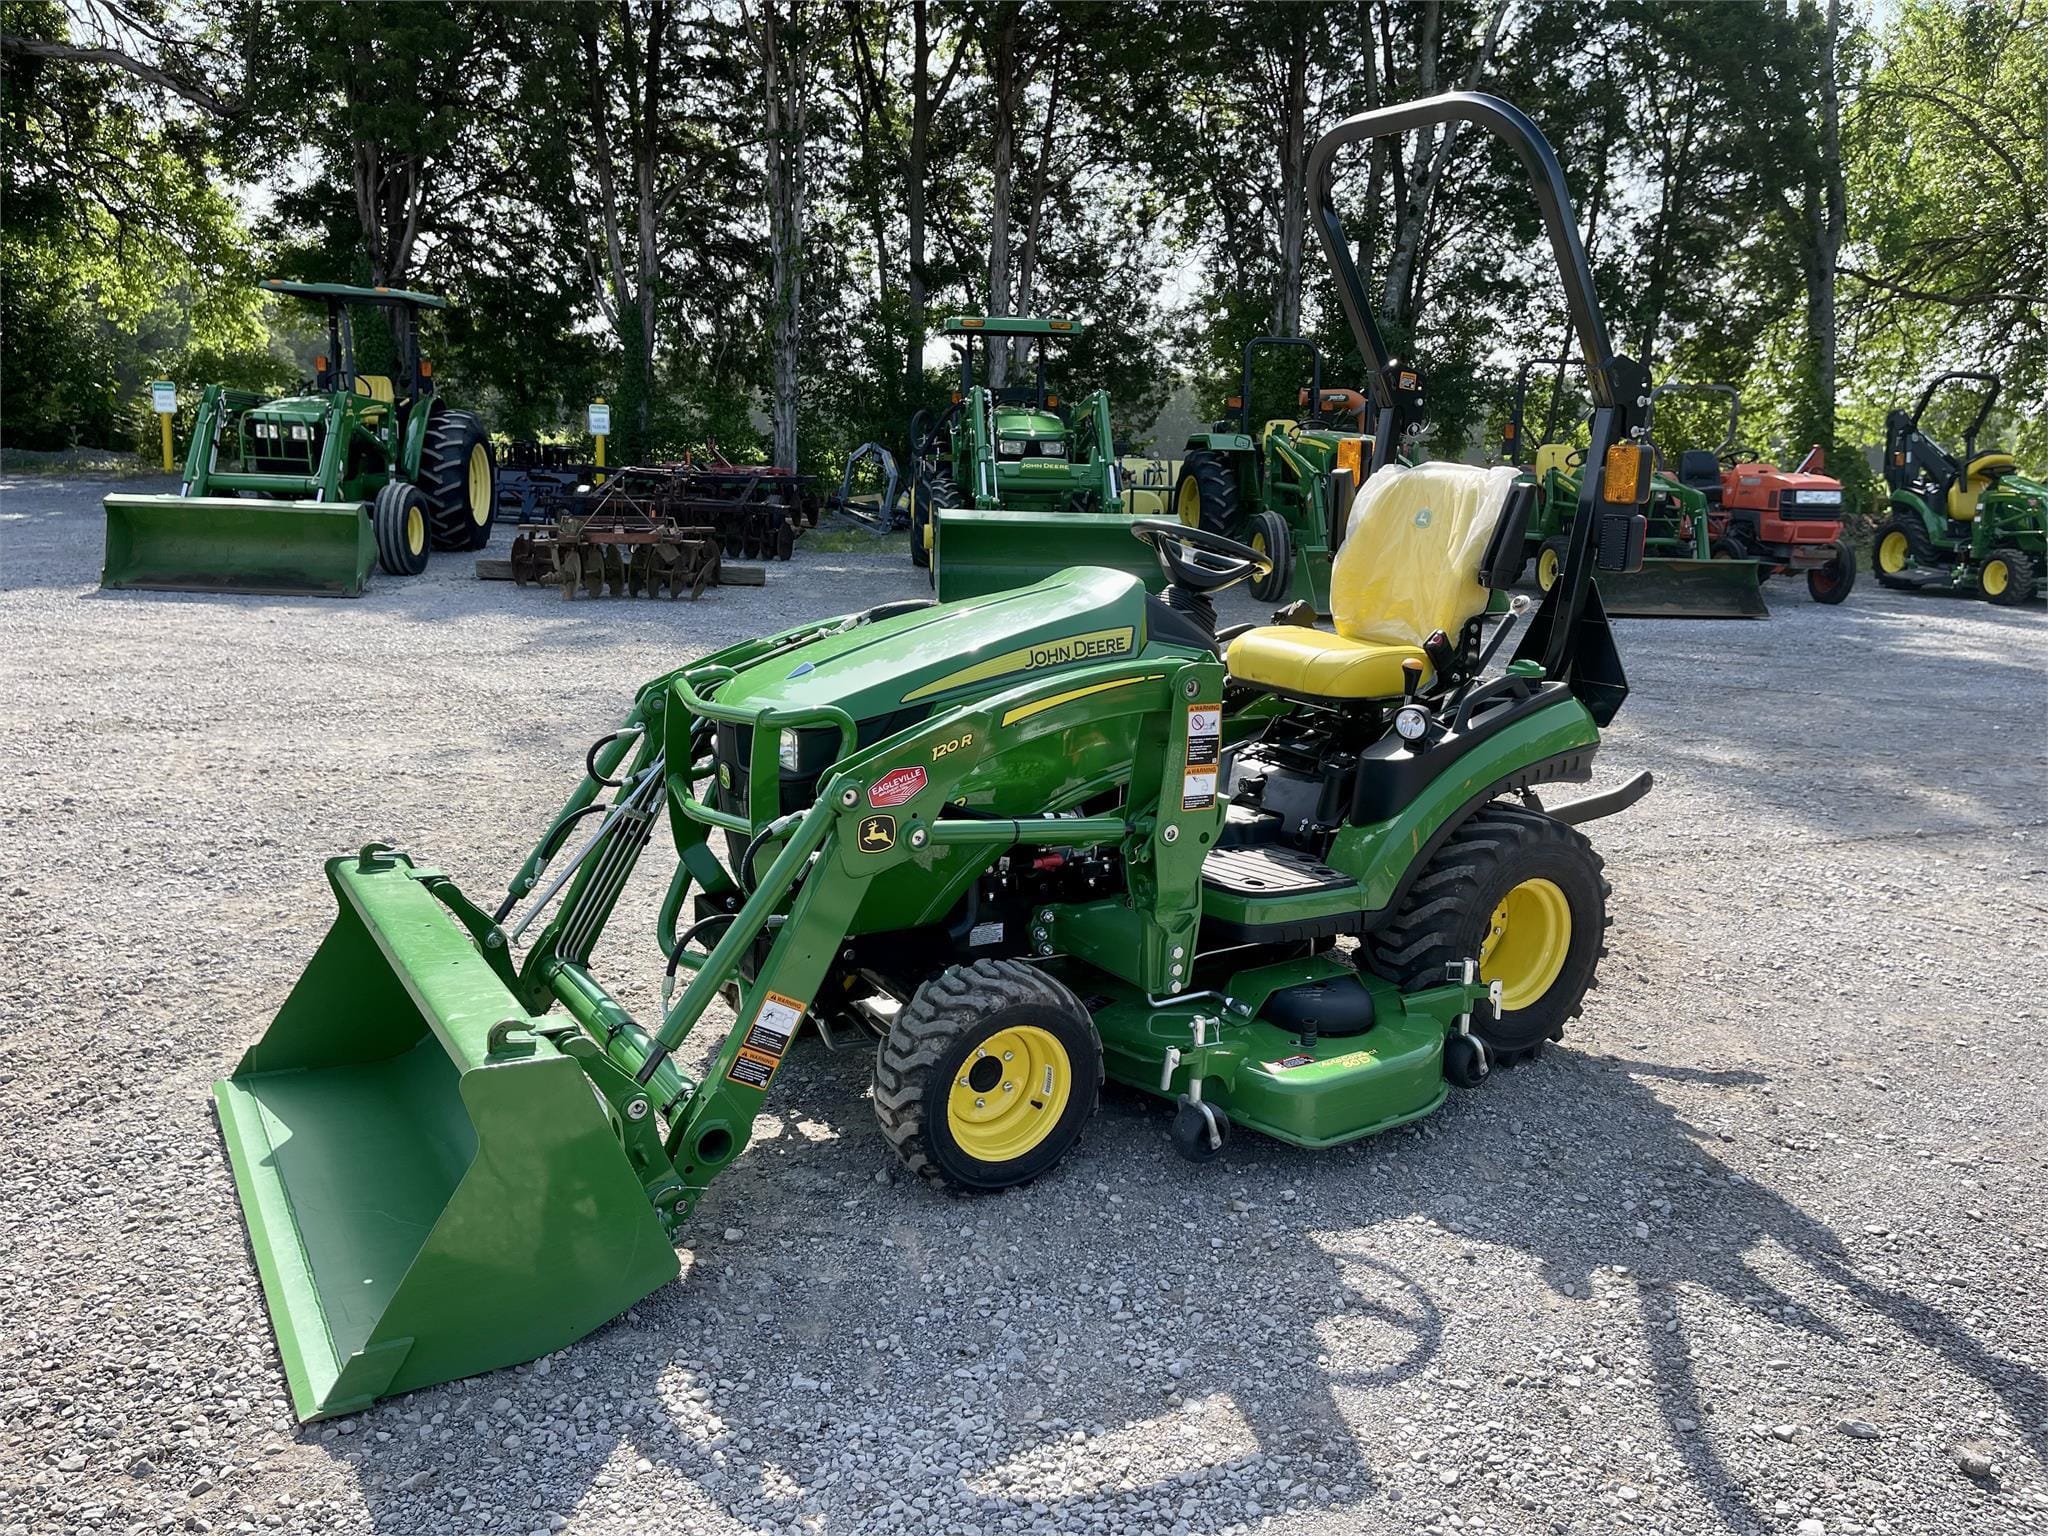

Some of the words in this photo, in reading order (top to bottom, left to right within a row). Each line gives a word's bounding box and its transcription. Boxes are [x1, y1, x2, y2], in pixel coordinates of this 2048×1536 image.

[1025, 644, 1071, 669] JOHN
[1075, 637, 1125, 658] DEERE
[1191, 767, 1216, 776] WARNING
[871, 768, 922, 796] EAGLEVILLE
[777, 996, 802, 1010] WARNING
[749, 1053, 775, 1067] WARNING
